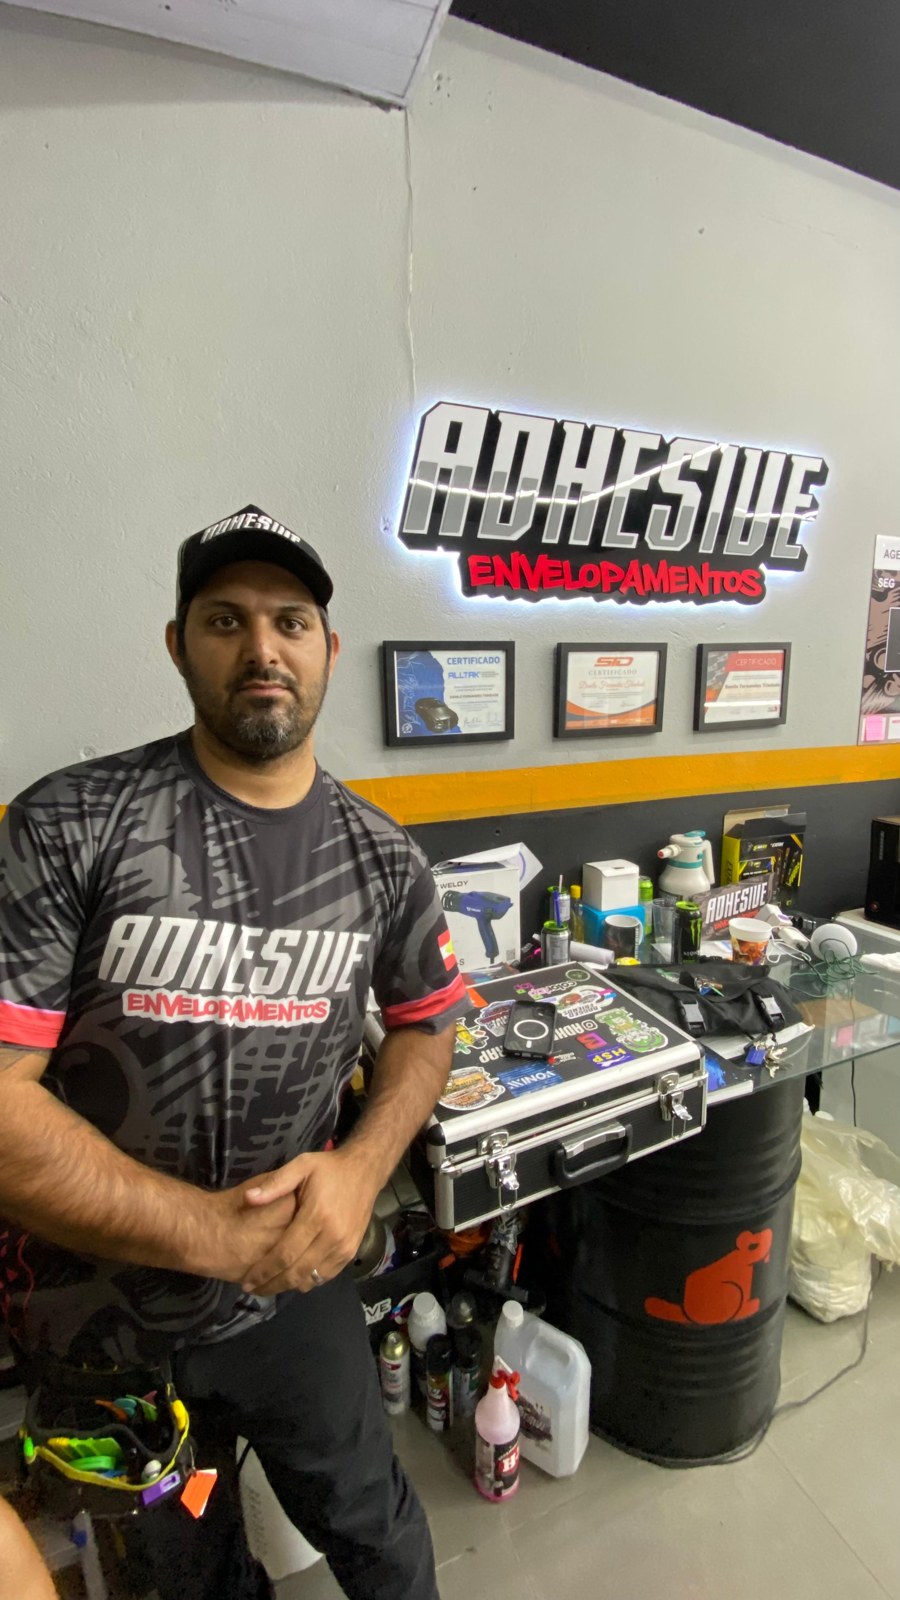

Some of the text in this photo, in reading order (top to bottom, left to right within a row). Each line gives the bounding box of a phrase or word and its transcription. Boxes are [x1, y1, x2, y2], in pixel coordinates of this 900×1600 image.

[403, 403, 823, 558] ADHESIVE
[467, 551, 763, 597] ENVELOPAMENTOS
[878, 577, 895, 588] SEG
[447, 656, 501, 666] CERTIFICADO
[440, 880, 469, 889] WELDY
[705, 881, 768, 924] ADHESIVE
[98, 915, 371, 995] ADHESIVE
[127, 993, 328, 1022] ENVELOPAMENTOS
[592, 1047, 627, 1063] HSP
